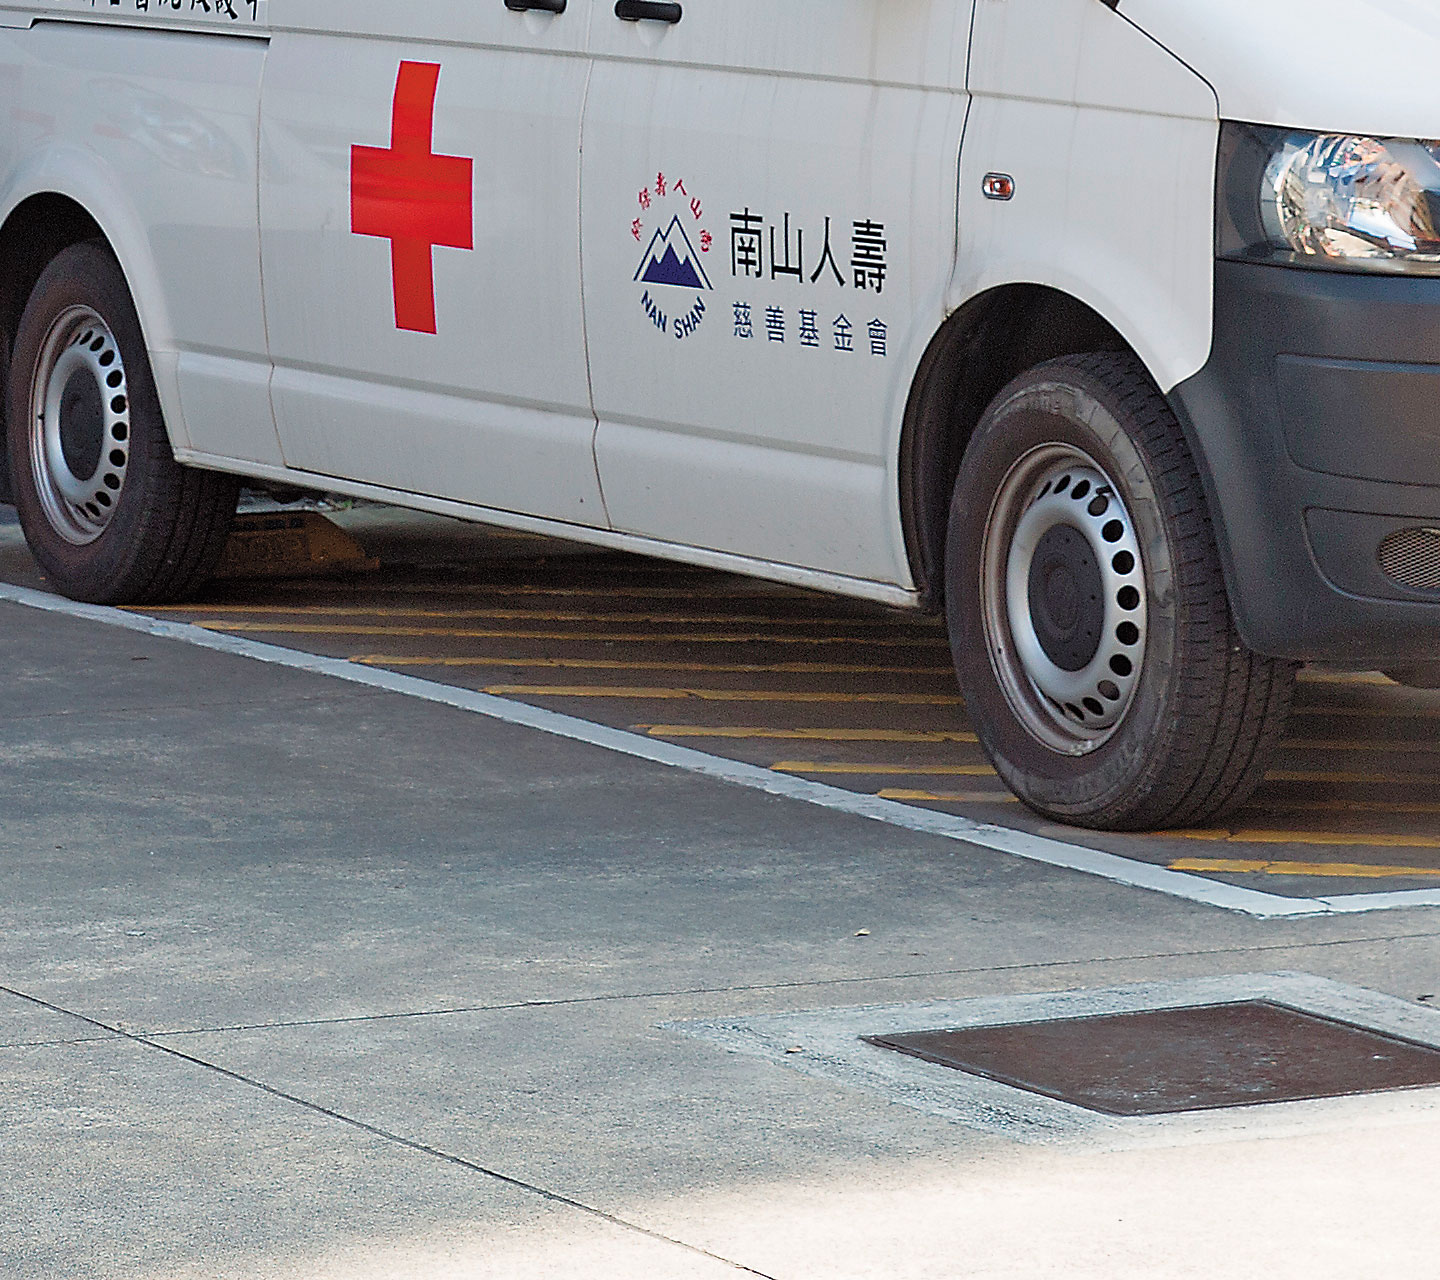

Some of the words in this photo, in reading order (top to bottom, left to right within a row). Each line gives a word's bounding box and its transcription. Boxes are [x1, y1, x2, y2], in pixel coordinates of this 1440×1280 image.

[729, 207, 887, 293] 南山人壽
[640, 290, 667, 333] NAN
[673, 296, 707, 340] SHAN
[732, 301, 888, 357] 慈善基金會
